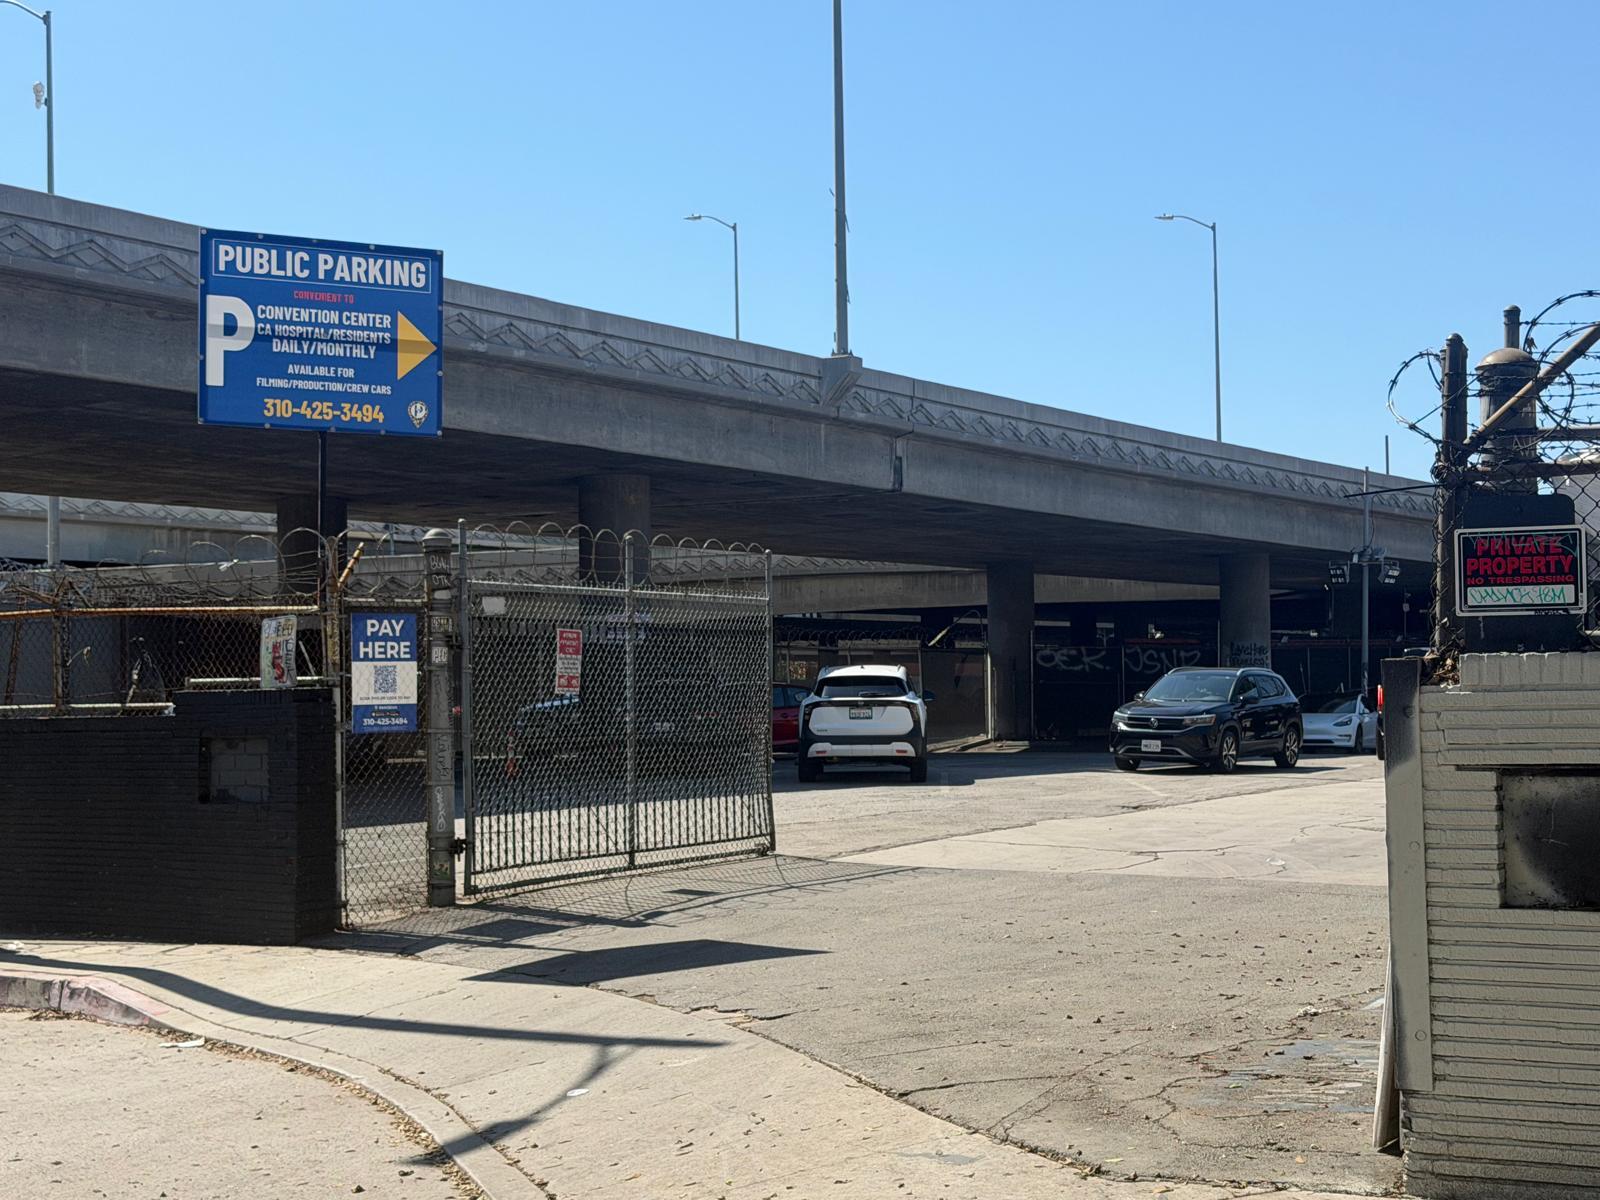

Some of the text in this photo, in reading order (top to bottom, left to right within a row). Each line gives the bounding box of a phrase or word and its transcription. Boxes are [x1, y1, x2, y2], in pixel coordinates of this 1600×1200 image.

[218, 244, 426, 288] PUBLIC PARKING
[294, 290, 354, 304] CONVENIENT TO
[257, 305, 391, 328] CONVENTION CENTER
[205, 294, 256, 387] P
[257, 323, 391, 344] CA HOSPITAL/RESIDENTS
[272, 338, 376, 359] DAILY/MONTHLY
[288, 364, 354, 378] AVAILABLE FOR
[256, 377, 391, 395] FILMING/PRODUCTION/CREW CARS
[263, 398, 384, 423] 310-425-3494
[1476, 535, 1562, 556] PRIVATE
[1466, 555, 1573, 576] PROPERTY
[1466, 575, 1575, 586] NO TRESPASSING
[366, 619, 404, 637] PAY
[359, 641, 411, 659] HERE
[362, 717, 409, 726] 310-425-3494
